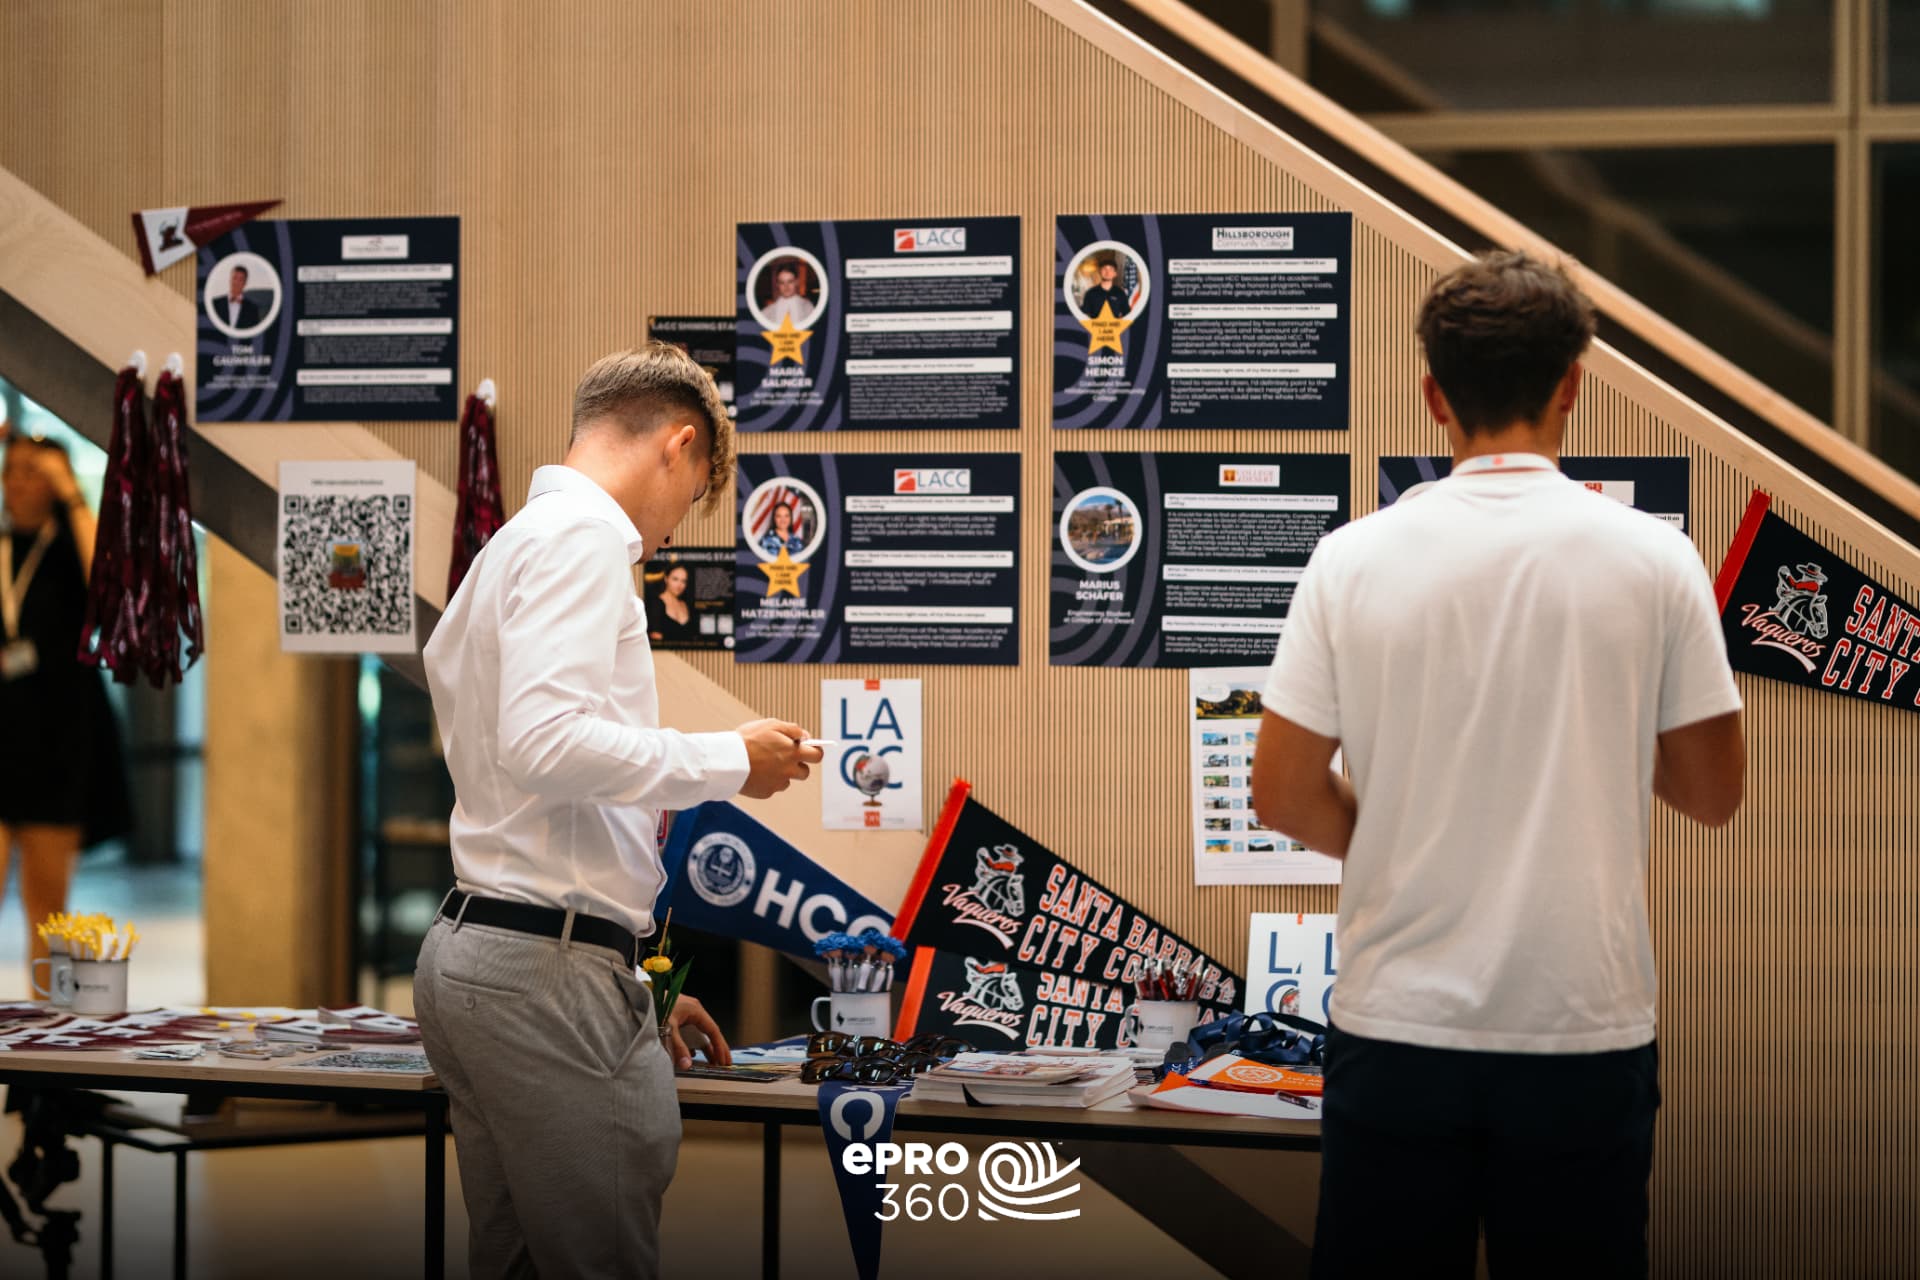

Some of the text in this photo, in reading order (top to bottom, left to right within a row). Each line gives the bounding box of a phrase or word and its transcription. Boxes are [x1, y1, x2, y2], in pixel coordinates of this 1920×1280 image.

[916, 229, 963, 246] LACC
[1217, 240, 1289, 248] Community College
[769, 367, 804, 376] MARIA
[1085, 367, 1125, 377] HEINZE
[1088, 355, 1123, 365] SIMON
[917, 470, 969, 488] LACC
[760, 598, 806, 608] MELANIE
[1075, 589, 1123, 600] SCHÄFER
[1079, 580, 1120, 589] MARIUS
[1741, 603, 1827, 658] Vaqueros
[1845, 584, 1920, 663] SANT
[1821, 637, 1910, 700] CITY
[840, 698, 904, 740] LA
[942, 884, 1024, 935] Vaqueros
[1039, 863, 1124, 941] SANTA
[1018, 914, 1101, 974] CITY
[936, 991, 1024, 1028] Vaqueros
[1036, 971, 1124, 1014] SANTA
[1025, 1003, 1106, 1048] CITY
